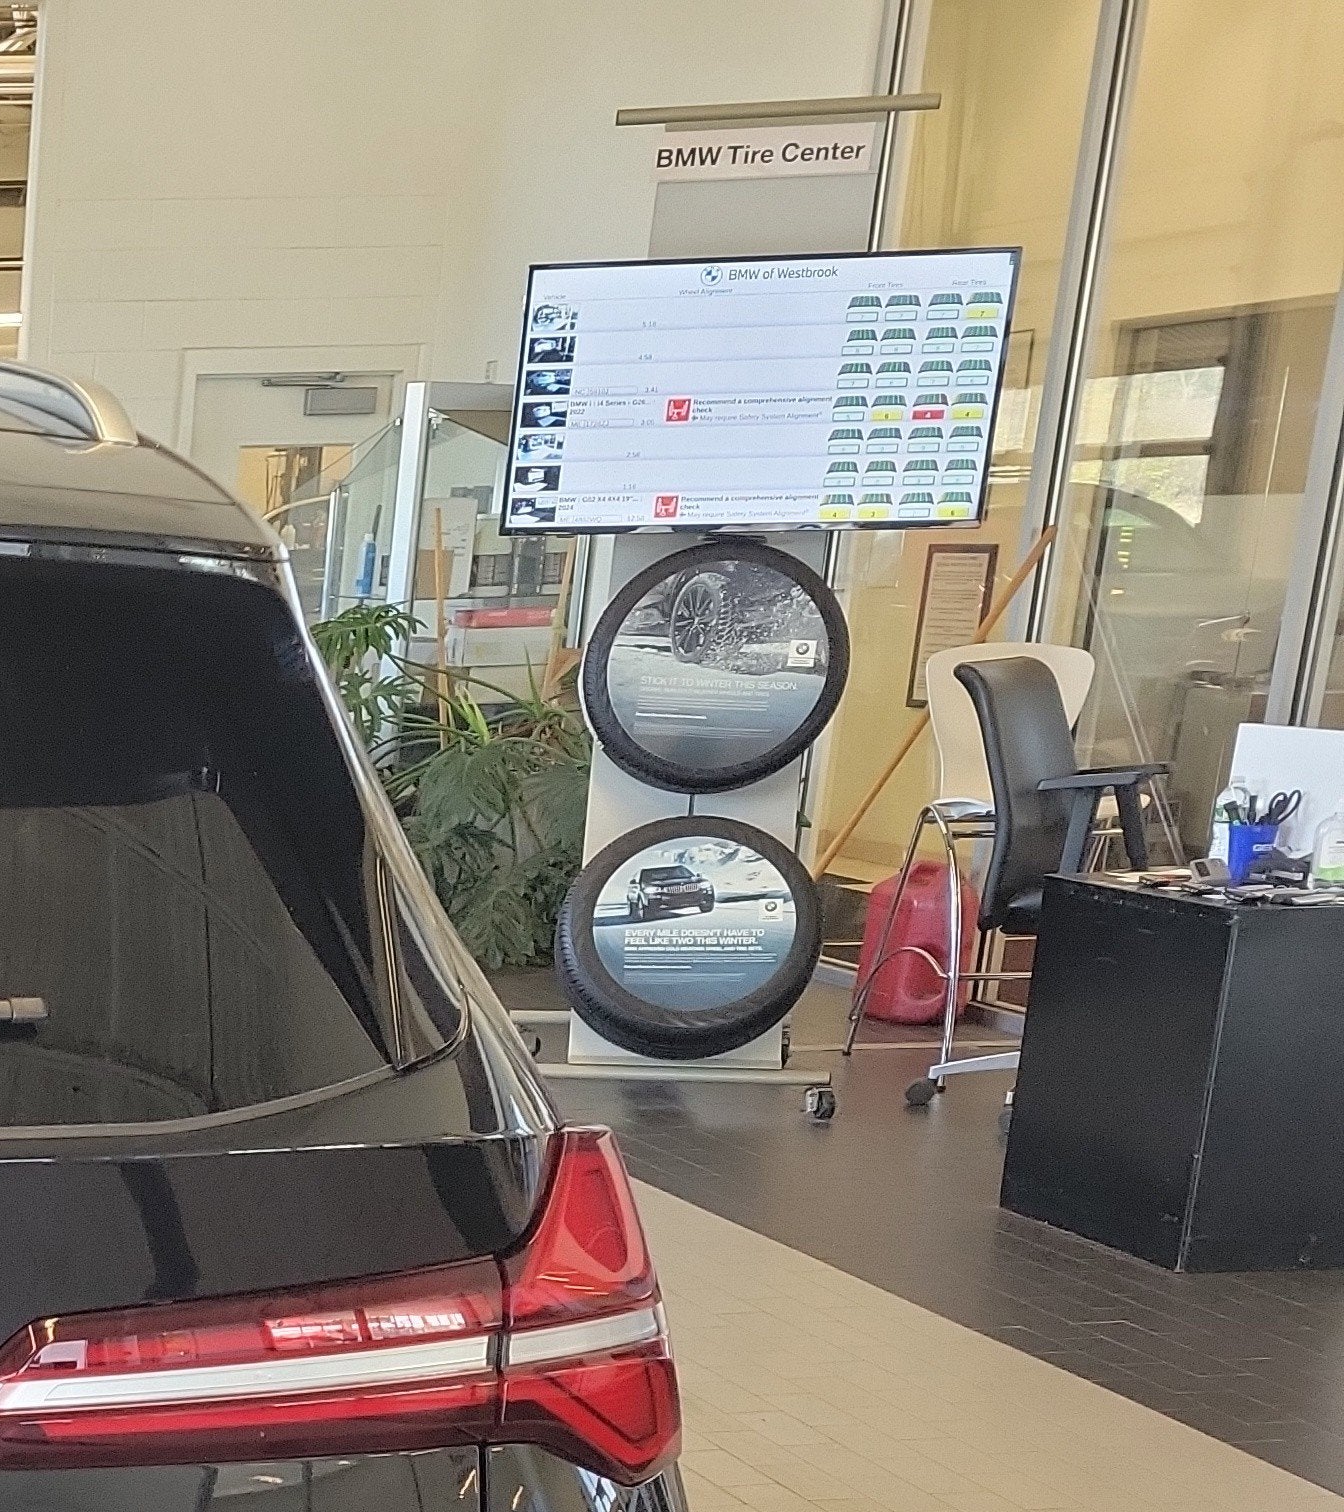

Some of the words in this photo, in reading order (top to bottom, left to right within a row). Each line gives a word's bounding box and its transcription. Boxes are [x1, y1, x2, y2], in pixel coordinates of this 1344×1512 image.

[656, 146, 723, 168] BMW
[727, 144, 774, 165] Tire
[781, 142, 866, 163] Center
[728, 269, 761, 281] BMW
[762, 267, 775, 280] of
[777, 266, 839, 279] Westbrook
[700, 288, 733, 296] Alignment
[743, 397, 796, 405] comprehensive
[797, 396, 833, 404] alignment
[731, 494, 783, 502] comprehensive
[641, 675, 667, 686] STICK
[668, 677, 677, 686] IT
[681, 678, 695, 687] TO
[696, 679, 731, 689] WINTER
[735, 680, 755, 689] THIS
[624, 929, 656, 937] EVERY
[656, 929, 680, 937] MILE
[681, 929, 722, 937] DOESN'T
[723, 929, 750, 937] HAVE
[751, 928, 765, 937] TO
[624, 937, 648, 945] FEEL
[649, 937, 670, 945] LIKE
[672, 937, 694, 945] TWO
[696, 937, 718, 945] THIS
[719, 937, 759, 945] WINTER.
